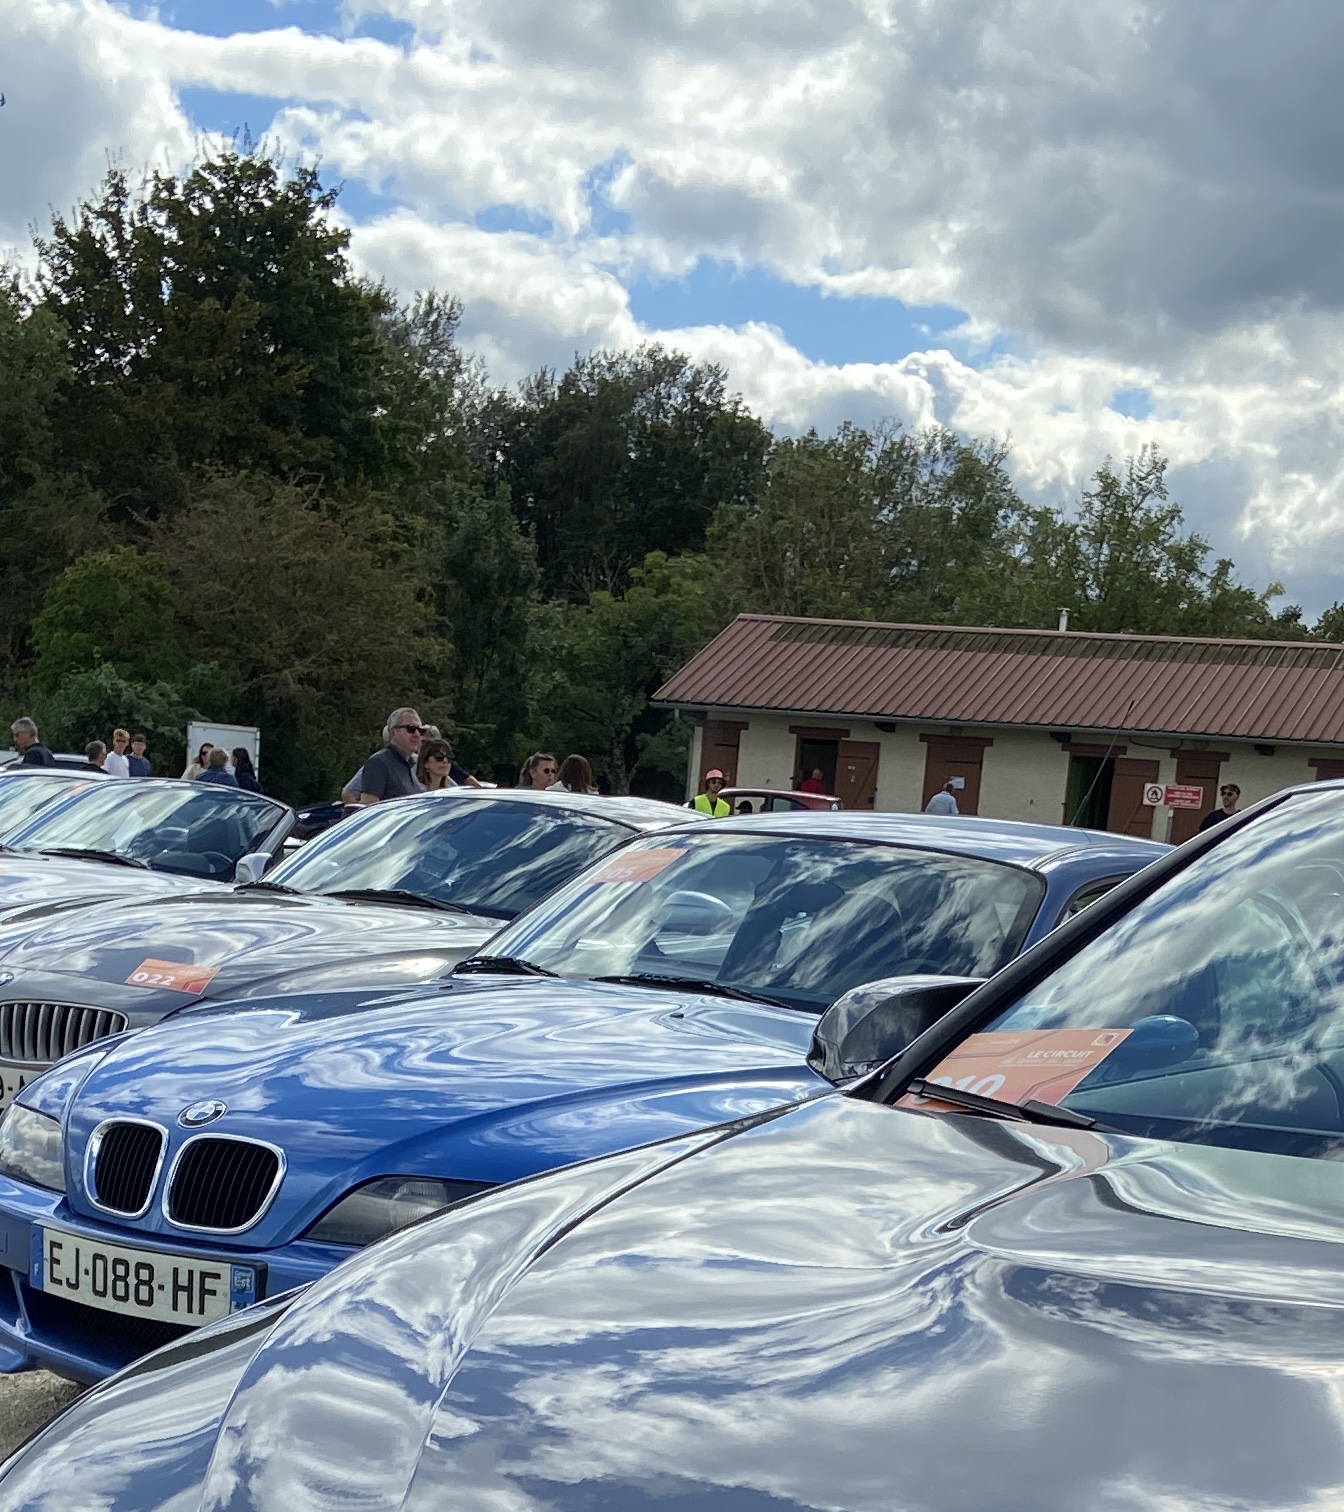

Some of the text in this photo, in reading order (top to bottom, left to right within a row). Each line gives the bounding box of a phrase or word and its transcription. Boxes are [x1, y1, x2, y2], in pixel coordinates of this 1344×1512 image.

[132, 972, 175, 986] 022
[1026, 1050, 1095, 1059] LE CIRCUIT
[49, 1239, 222, 1316] EJ-088-HF
